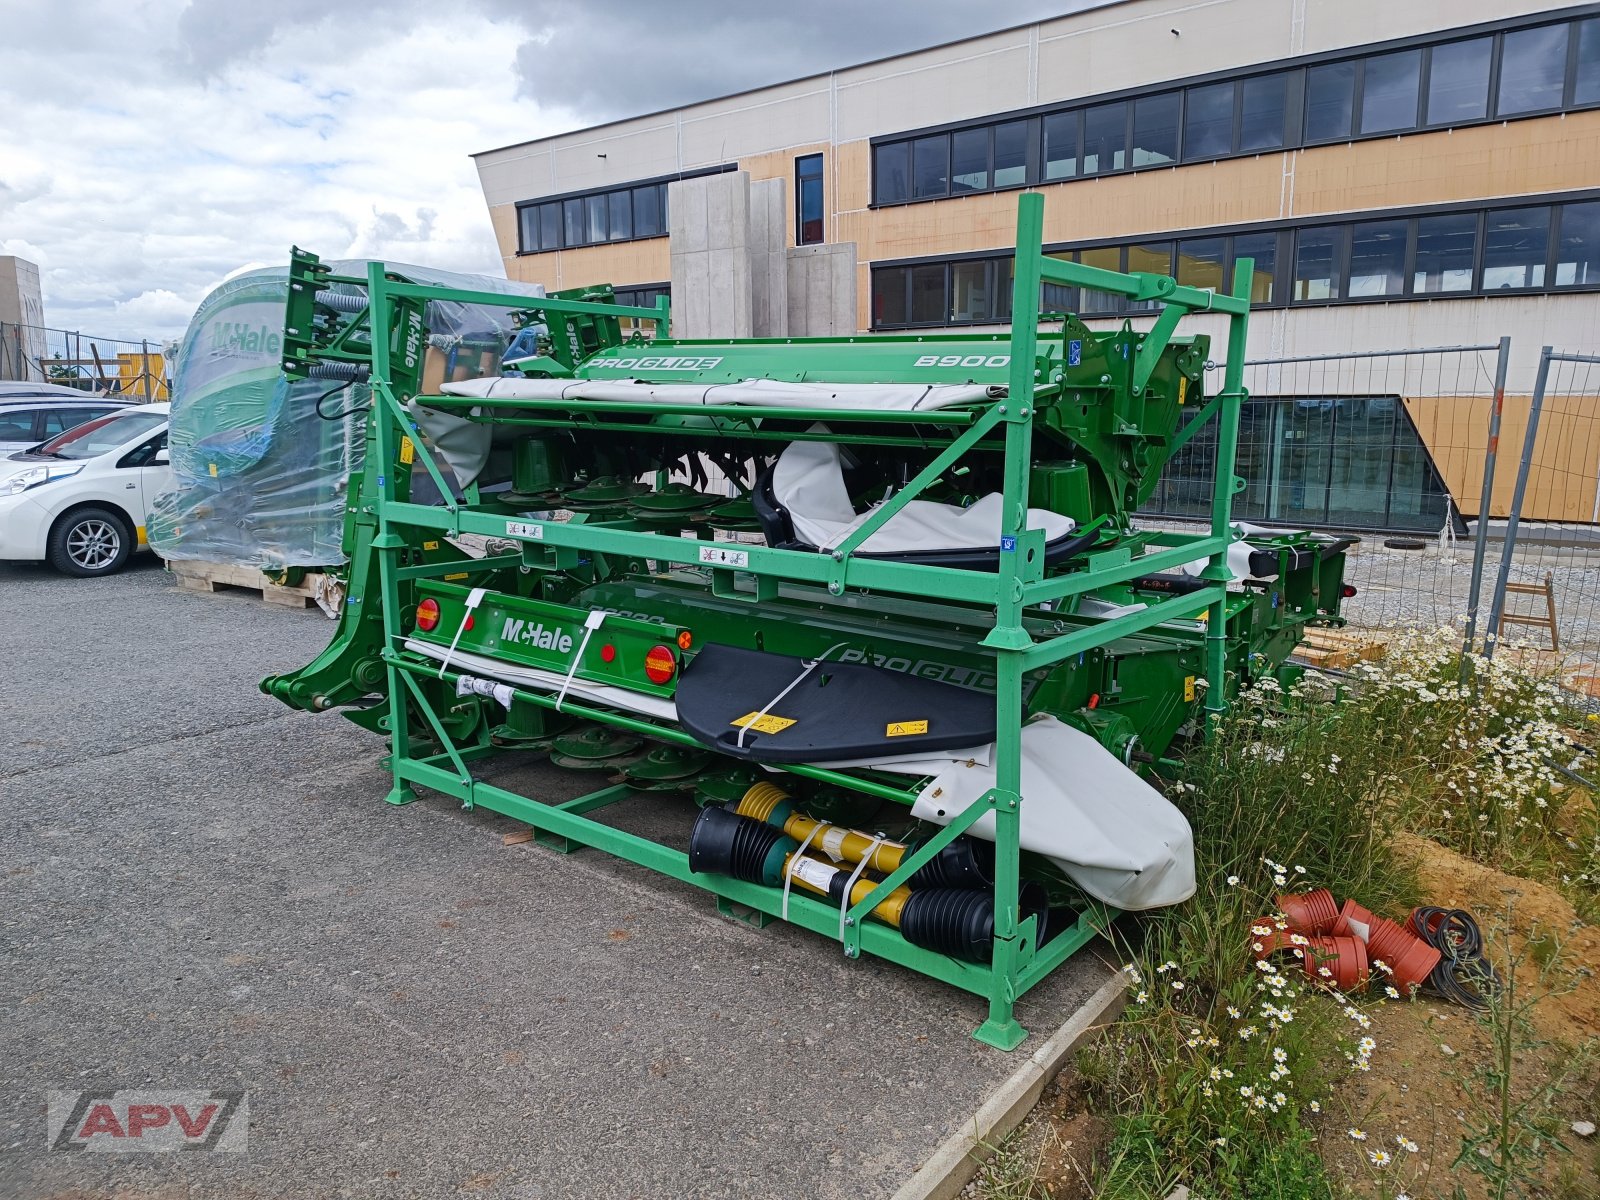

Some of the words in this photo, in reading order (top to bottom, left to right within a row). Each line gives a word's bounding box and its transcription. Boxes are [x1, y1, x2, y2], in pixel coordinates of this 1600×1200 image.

[405, 310, 421, 368] McHale
[584, 357, 721, 370] PROGLIDE
[501, 617, 573, 654] McHale
